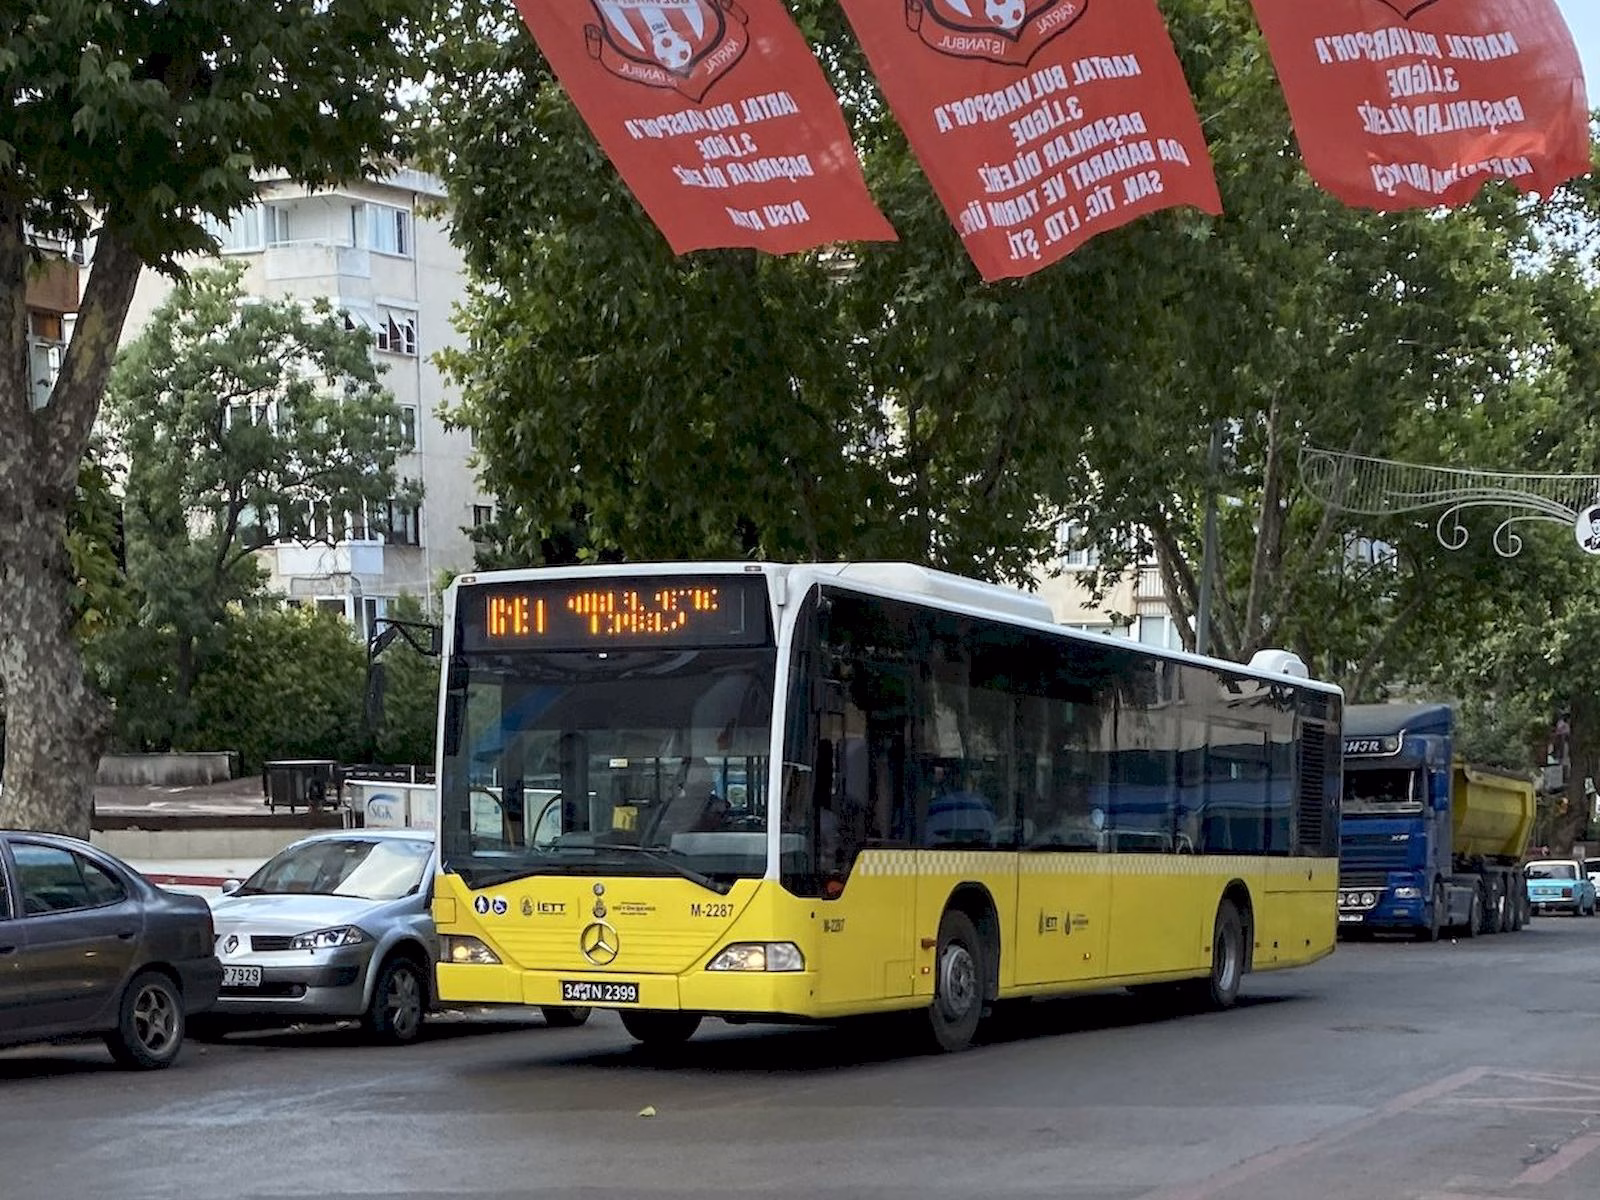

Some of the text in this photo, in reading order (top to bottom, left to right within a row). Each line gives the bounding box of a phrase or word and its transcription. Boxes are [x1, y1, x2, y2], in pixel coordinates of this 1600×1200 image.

[691, 903, 734, 918] M-2287
[231, 968, 259, 982] 7929
[564, 983, 580, 999] 34
[605, 985, 636, 1001] 2399
